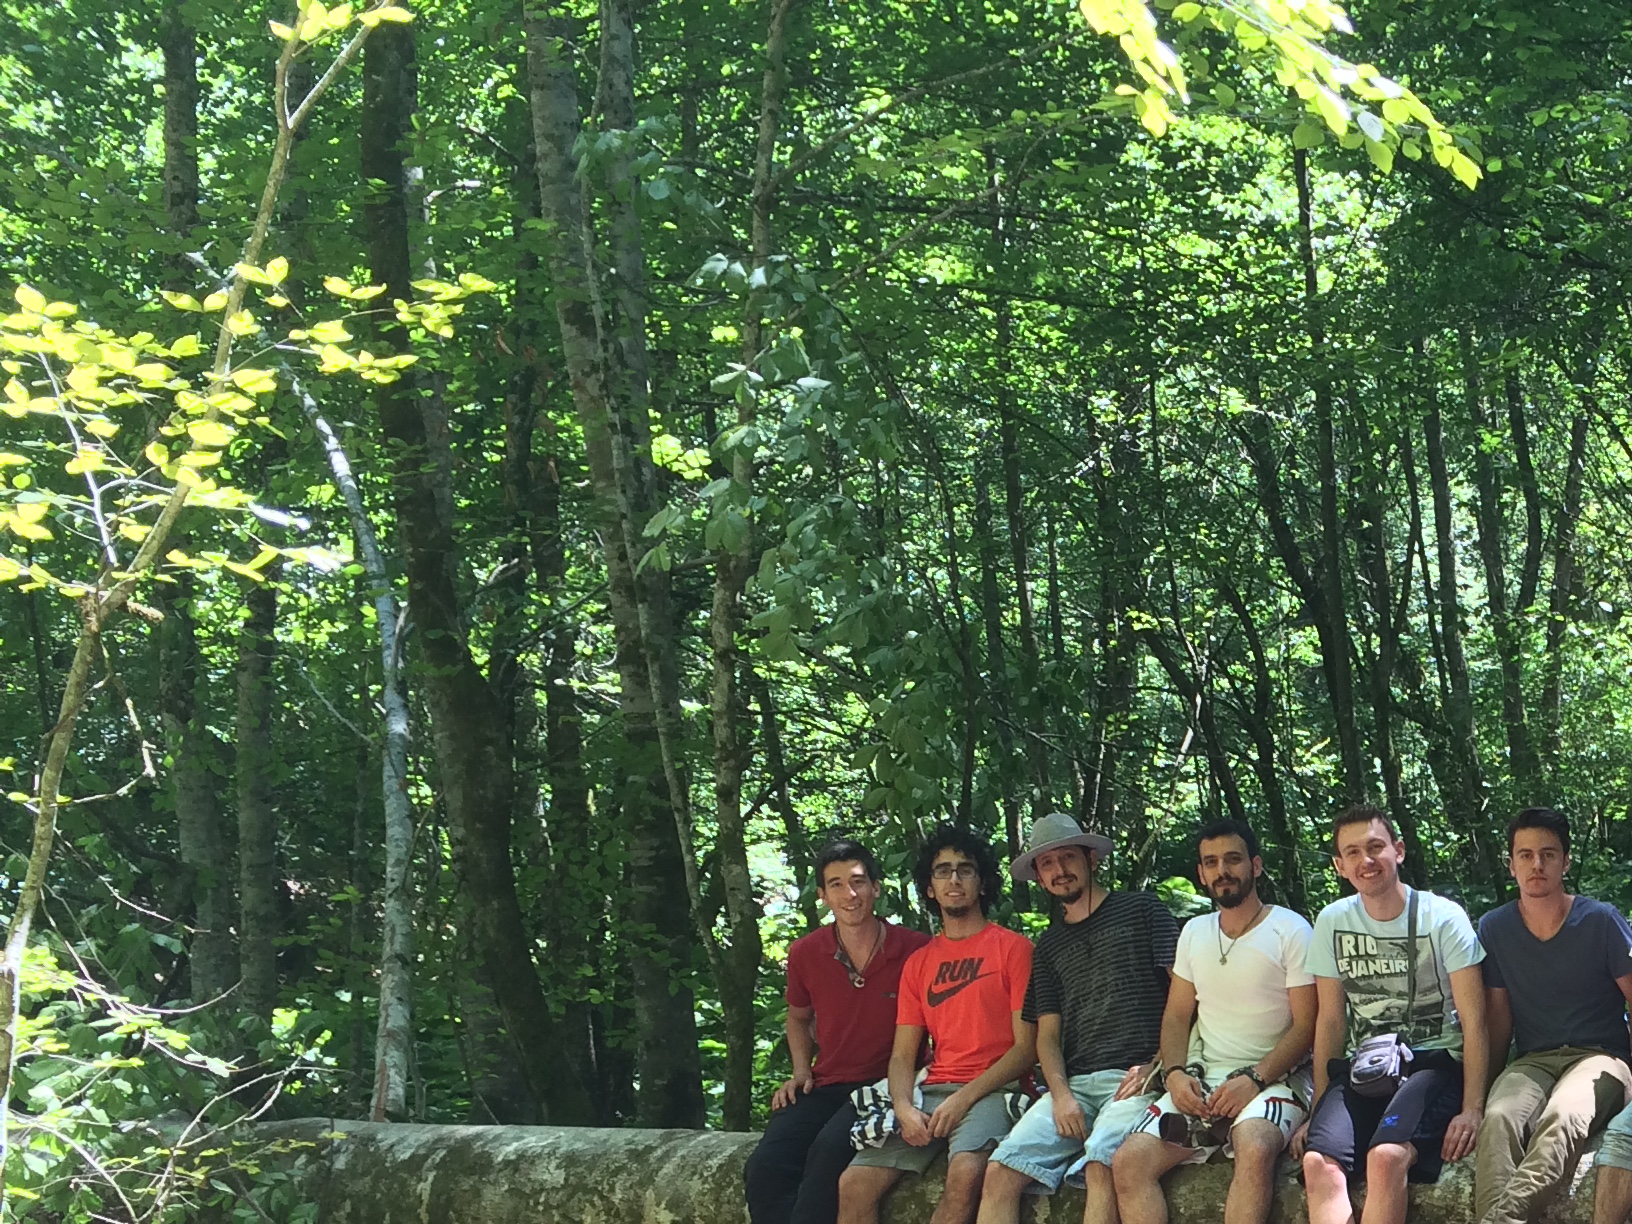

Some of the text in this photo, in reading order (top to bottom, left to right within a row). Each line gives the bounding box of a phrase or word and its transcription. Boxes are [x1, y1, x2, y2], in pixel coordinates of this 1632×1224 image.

[1341, 934, 1378, 957] RIO
[933, 957, 985, 986] RUN
[1337, 957, 1351, 973] DE
[1348, 958, 1409, 979] JANEIR
